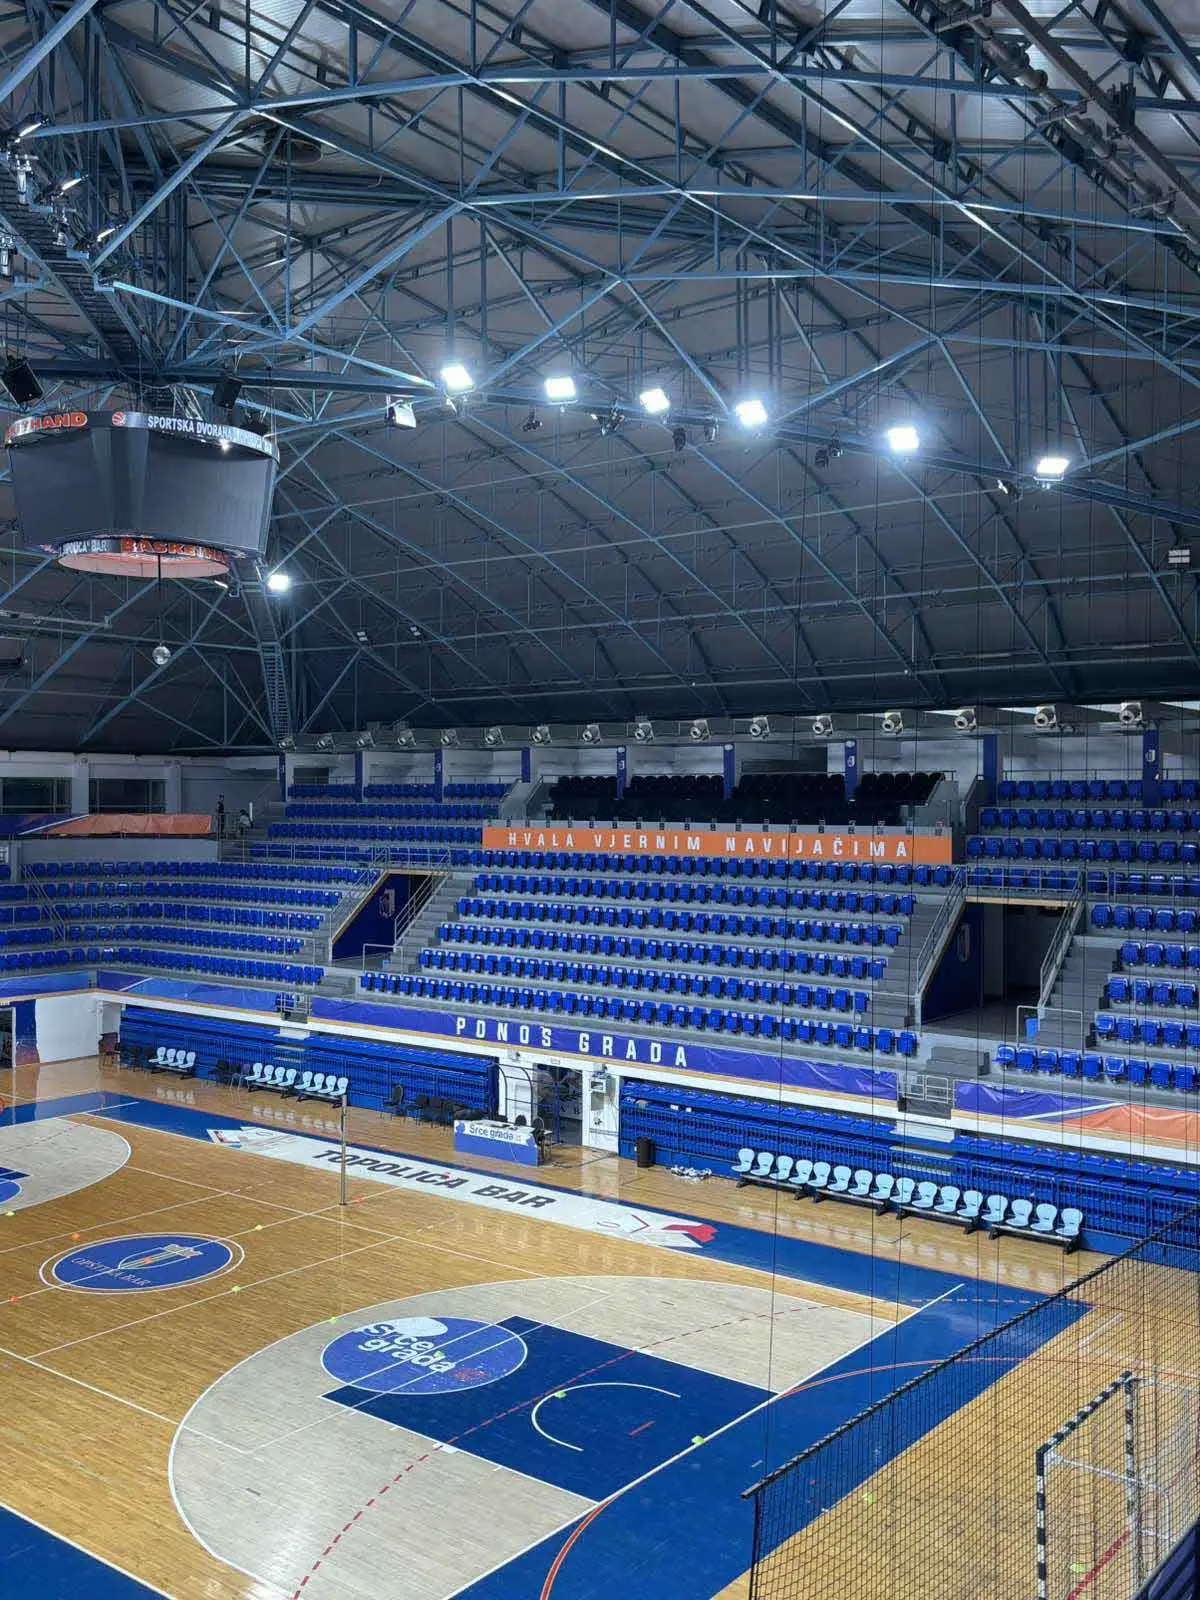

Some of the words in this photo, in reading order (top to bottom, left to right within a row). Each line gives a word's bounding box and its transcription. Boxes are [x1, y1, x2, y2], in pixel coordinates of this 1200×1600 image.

[147, 415, 194, 432] SPORTSKA
[508, 832, 574, 848] HVALA
[594, 834, 700, 851] VJERNIM
[725, 836, 907, 857] NAVIJAČIMA
[456, 1016, 552, 1047] PONOS
[579, 1032, 688, 1068] GRADA
[469, 1124, 488, 1137] Srce
[489, 1126, 514, 1141] grada
[312, 1149, 470, 1189] TOPOLICA
[470, 1184, 557, 1208] BAR
[363, 1323, 435, 1351] Srce
[358, 1338, 456, 1373] grada
